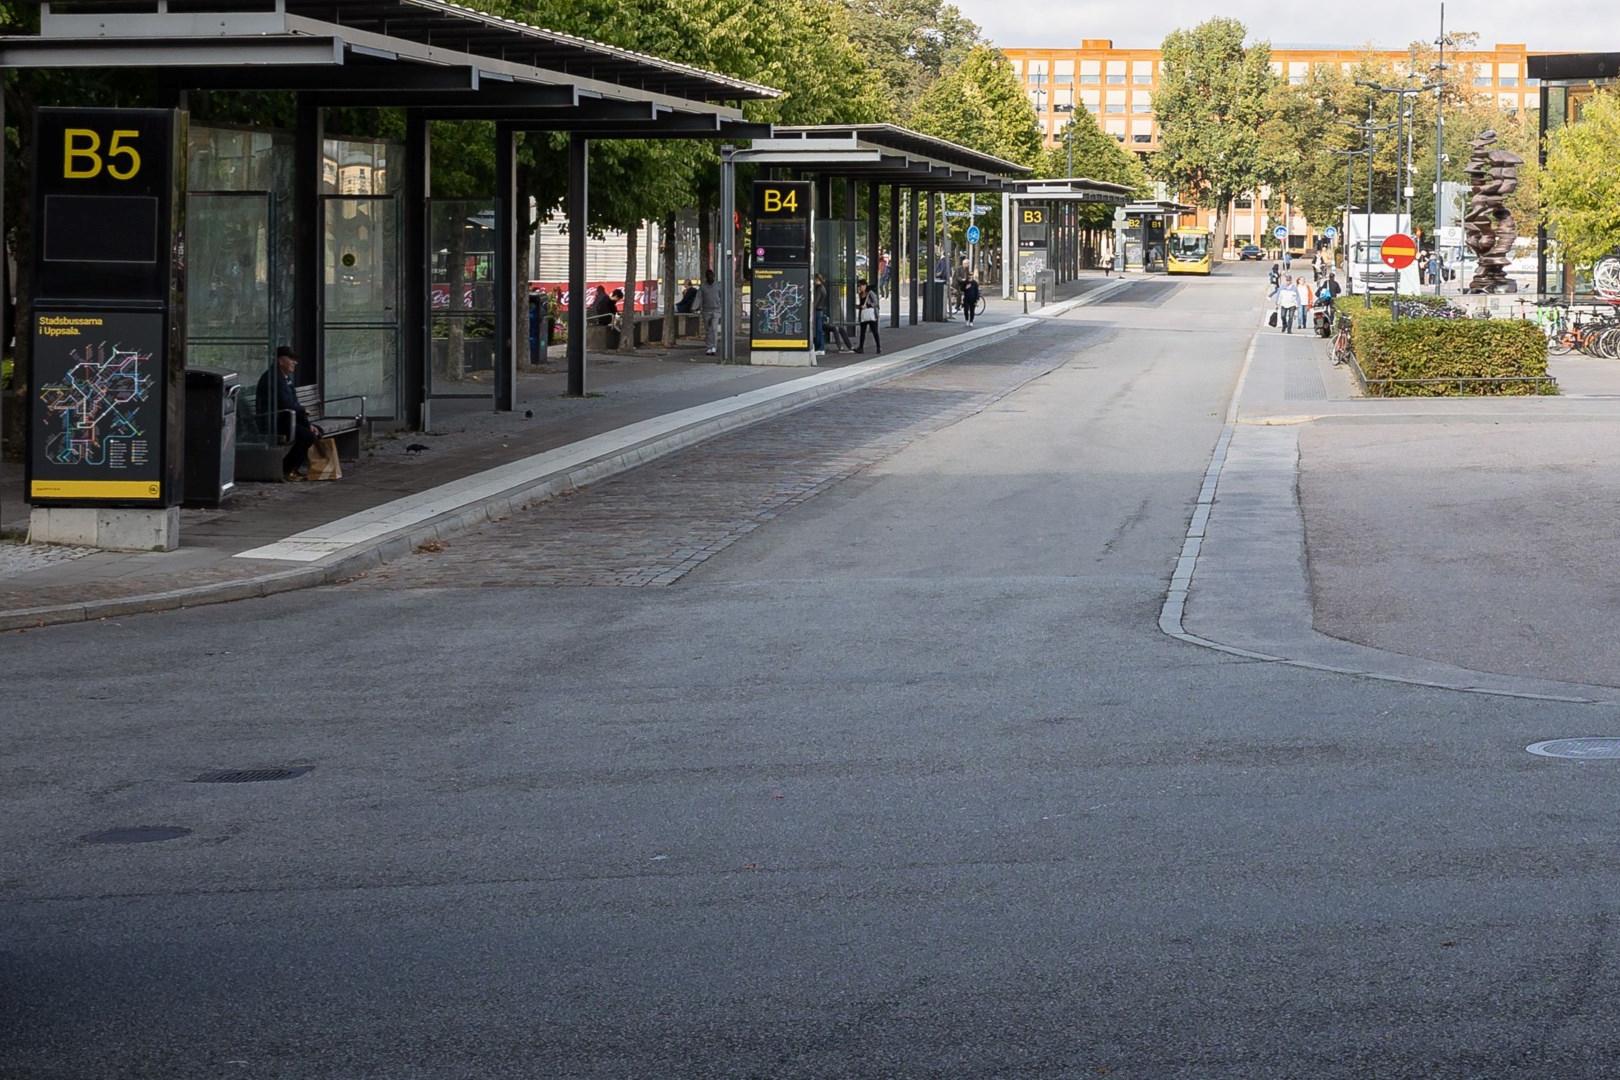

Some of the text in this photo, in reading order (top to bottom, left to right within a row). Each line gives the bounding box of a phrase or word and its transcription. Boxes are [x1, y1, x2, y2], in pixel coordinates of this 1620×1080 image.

[63, 128, 141, 180] B5
[764, 189, 798, 212] B4
[1023, 210, 1042, 223] B3
[1128, 219, 1140, 228] B2
[39, 316, 103, 326] Stadsbussarna
[44, 326, 81, 337] Uppsala.
